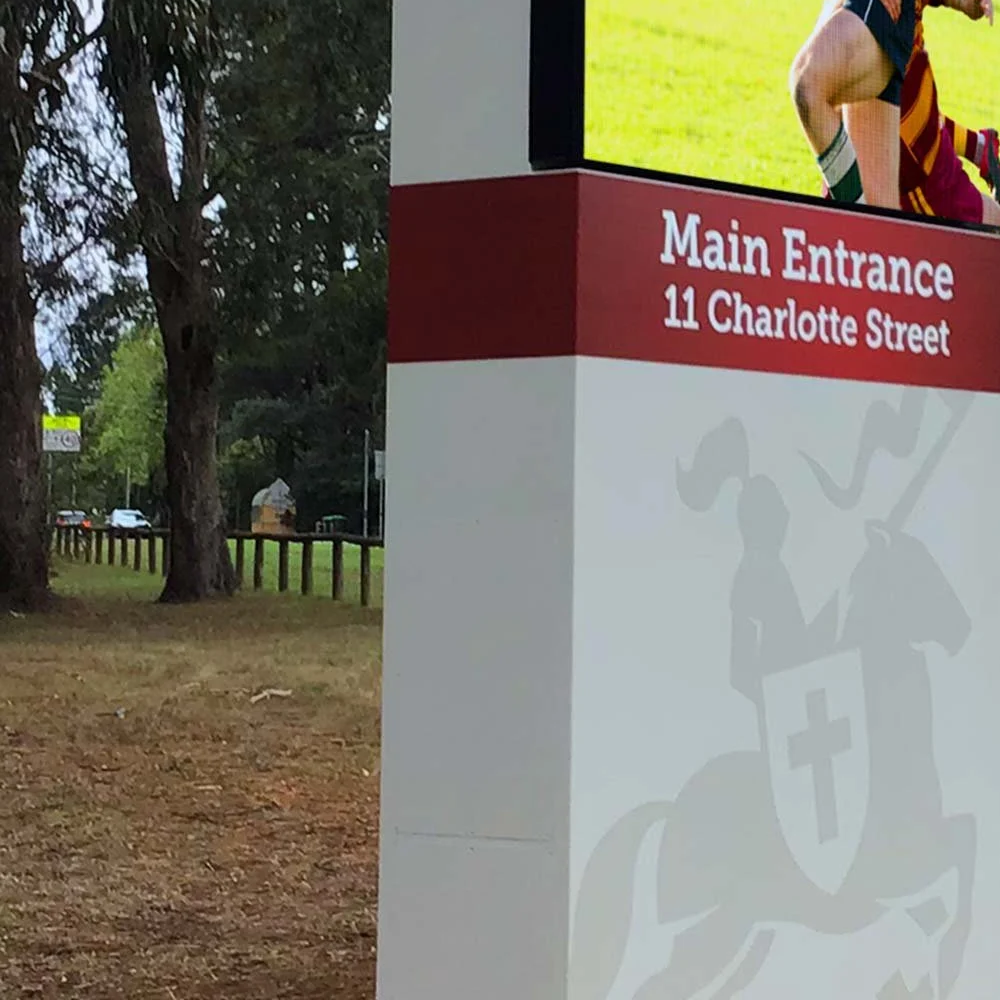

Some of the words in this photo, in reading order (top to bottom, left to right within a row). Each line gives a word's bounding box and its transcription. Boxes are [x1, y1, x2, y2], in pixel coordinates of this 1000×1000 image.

[660, 208, 771, 277] Main
[781, 226, 955, 301] Entrance
[663, 283, 700, 331] 11
[707, 288, 858, 347] Charlotte
[865, 307, 952, 357] Street
